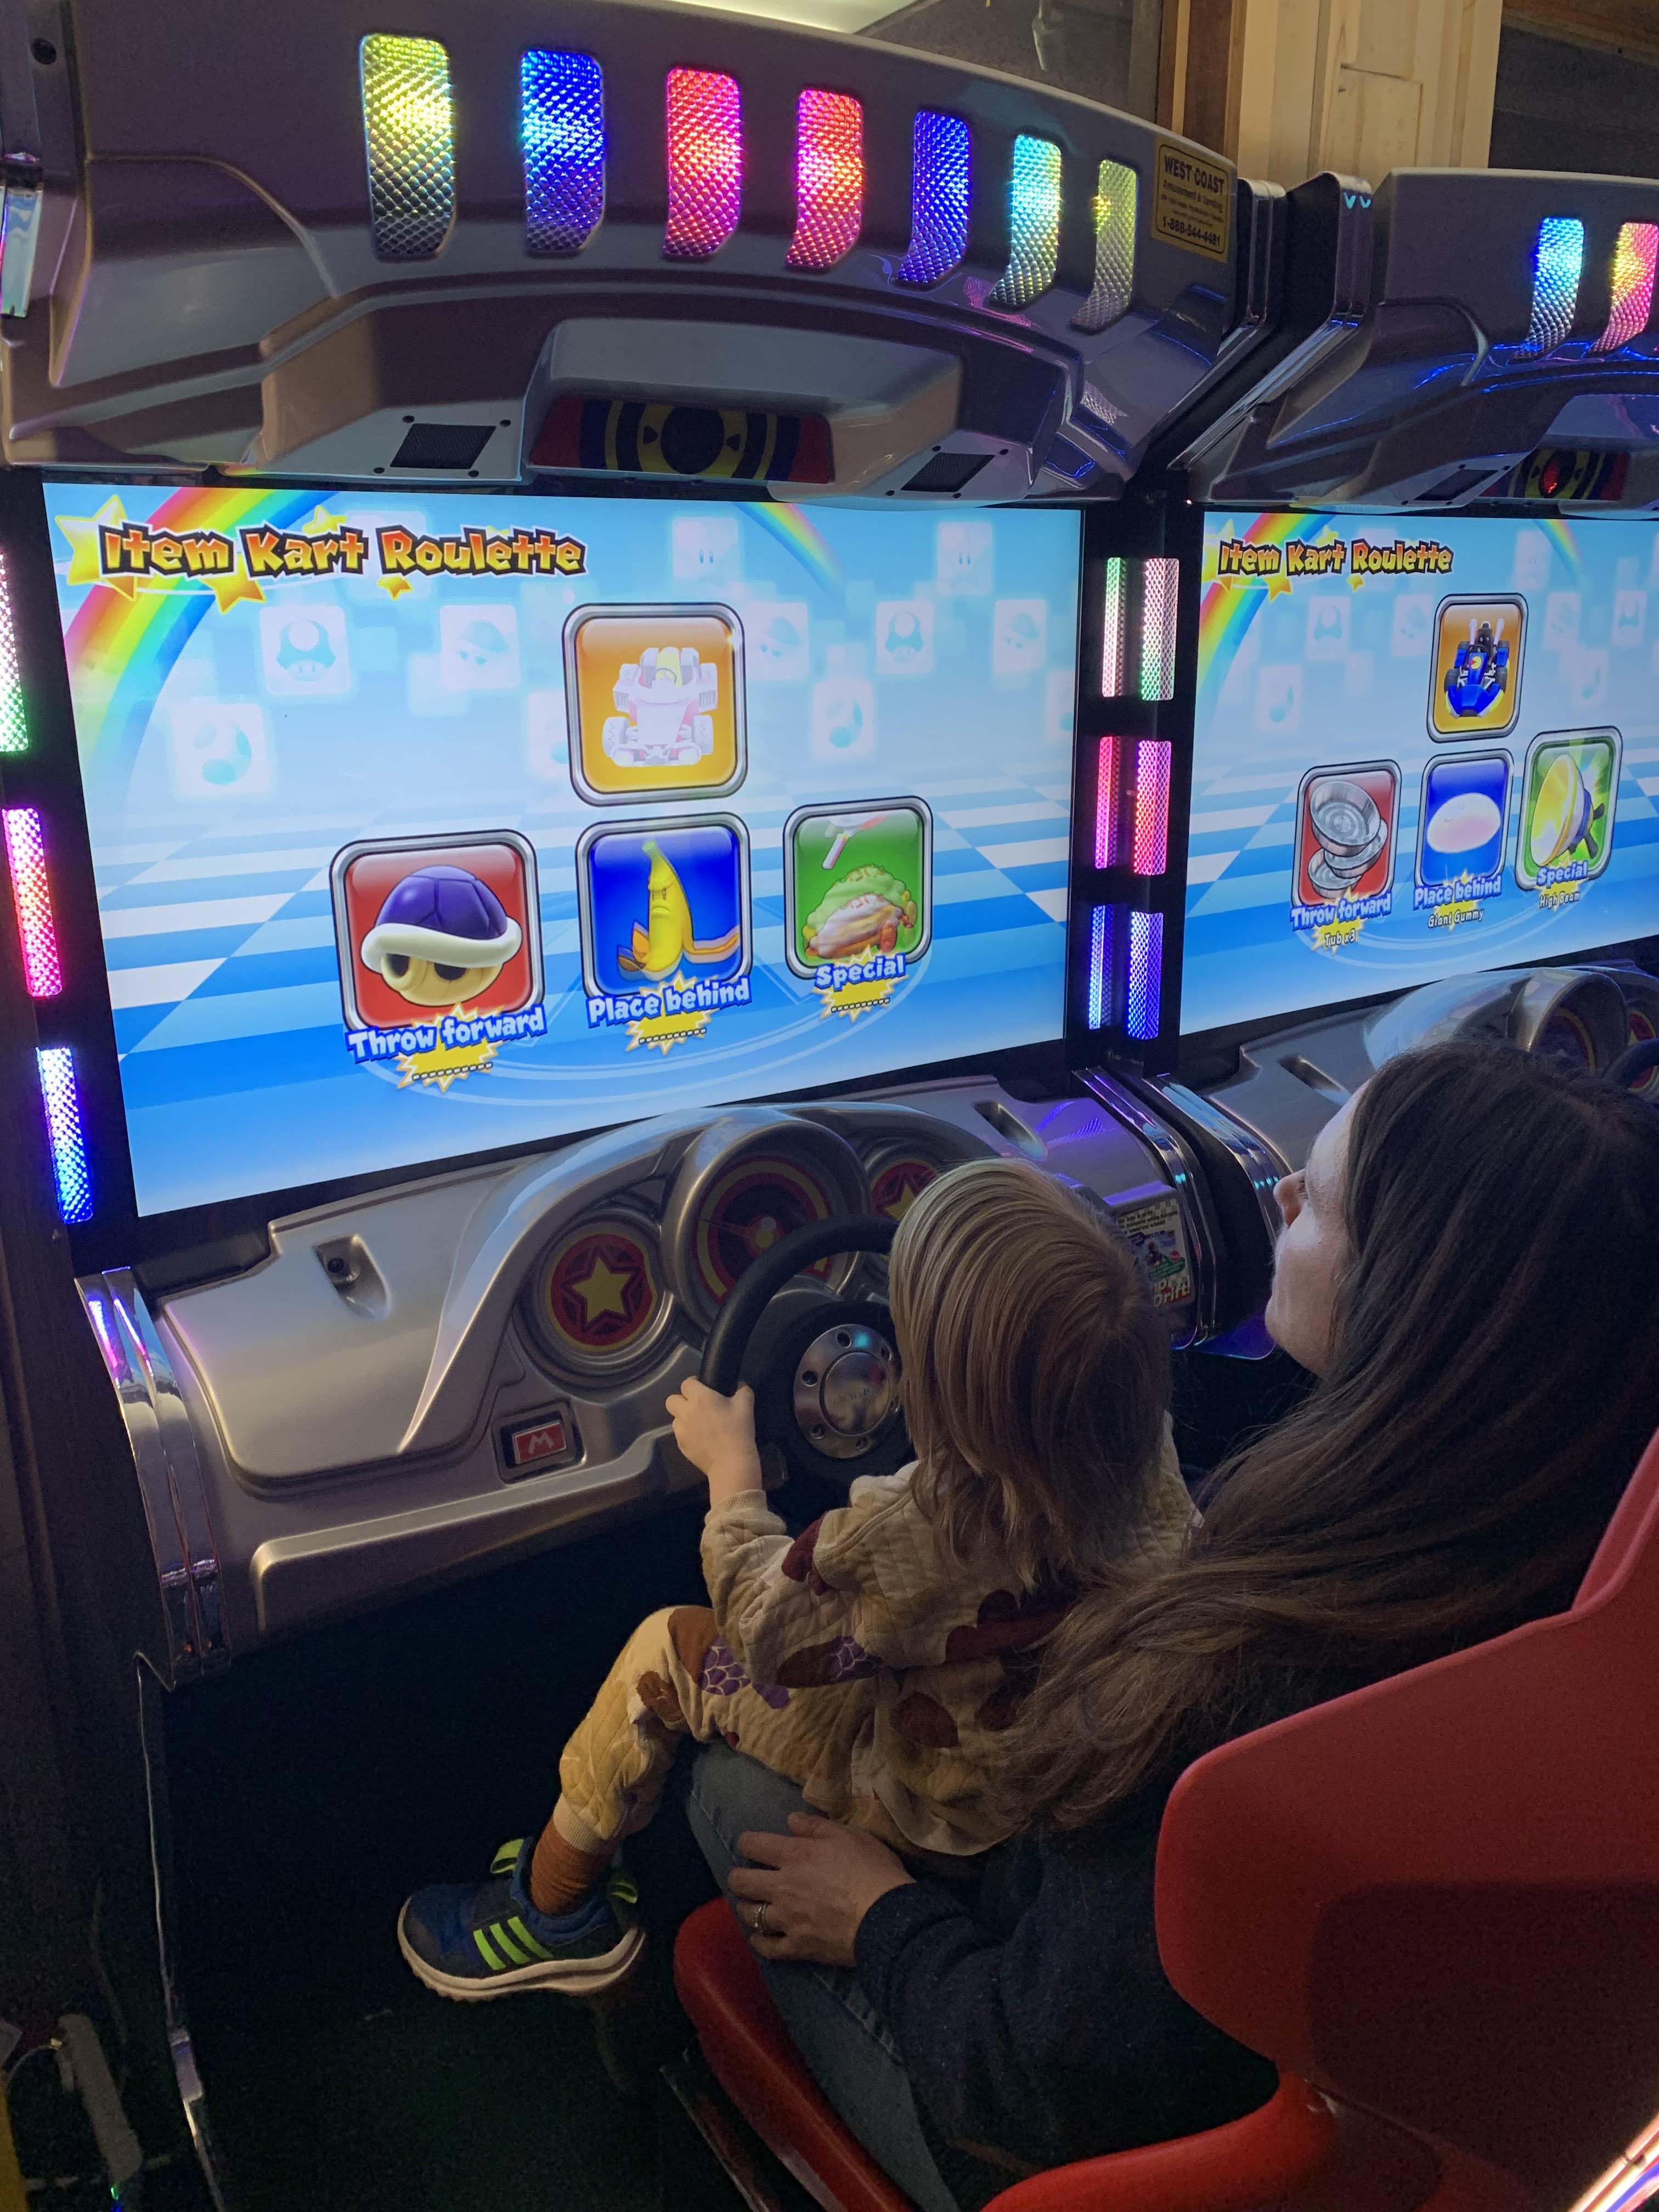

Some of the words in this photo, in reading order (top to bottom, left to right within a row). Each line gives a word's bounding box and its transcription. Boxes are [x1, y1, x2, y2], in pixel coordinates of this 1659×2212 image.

[1164, 154, 1192, 182] WEST
[1194, 167, 1224, 195] COAST
[99, 524, 234, 575] Item
[238, 524, 367, 577] Kart
[377, 526, 587, 577] Roulette
[1218, 539, 1282, 576] Item
[1285, 539, 1347, 576] Kart
[1351, 539, 1453, 574] Roulette
[1414, 886, 1452, 909] Place
[1454, 874, 1502, 901] behind
[1537, 861, 1588, 888] Special
[1291, 906, 1335, 929] Throw
[1338, 891, 1391, 920] forward
[1539, 893, 1558, 909] High
[1559, 891, 1580, 905] Beam
[1428, 912, 1452, 928] Giant
[1454, 909, 1484, 923] Gummy
[1324, 931, 1342, 947] Tub
[1345, 929, 1356, 944] x3
[815, 953, 905, 989] Special
[587, 995, 661, 1026] Place
[664, 977, 751, 1014] behind
[346, 1028, 436, 1061] Throw
[441, 1005, 546, 1048] forward
[528, 1431, 554, 1453] M
